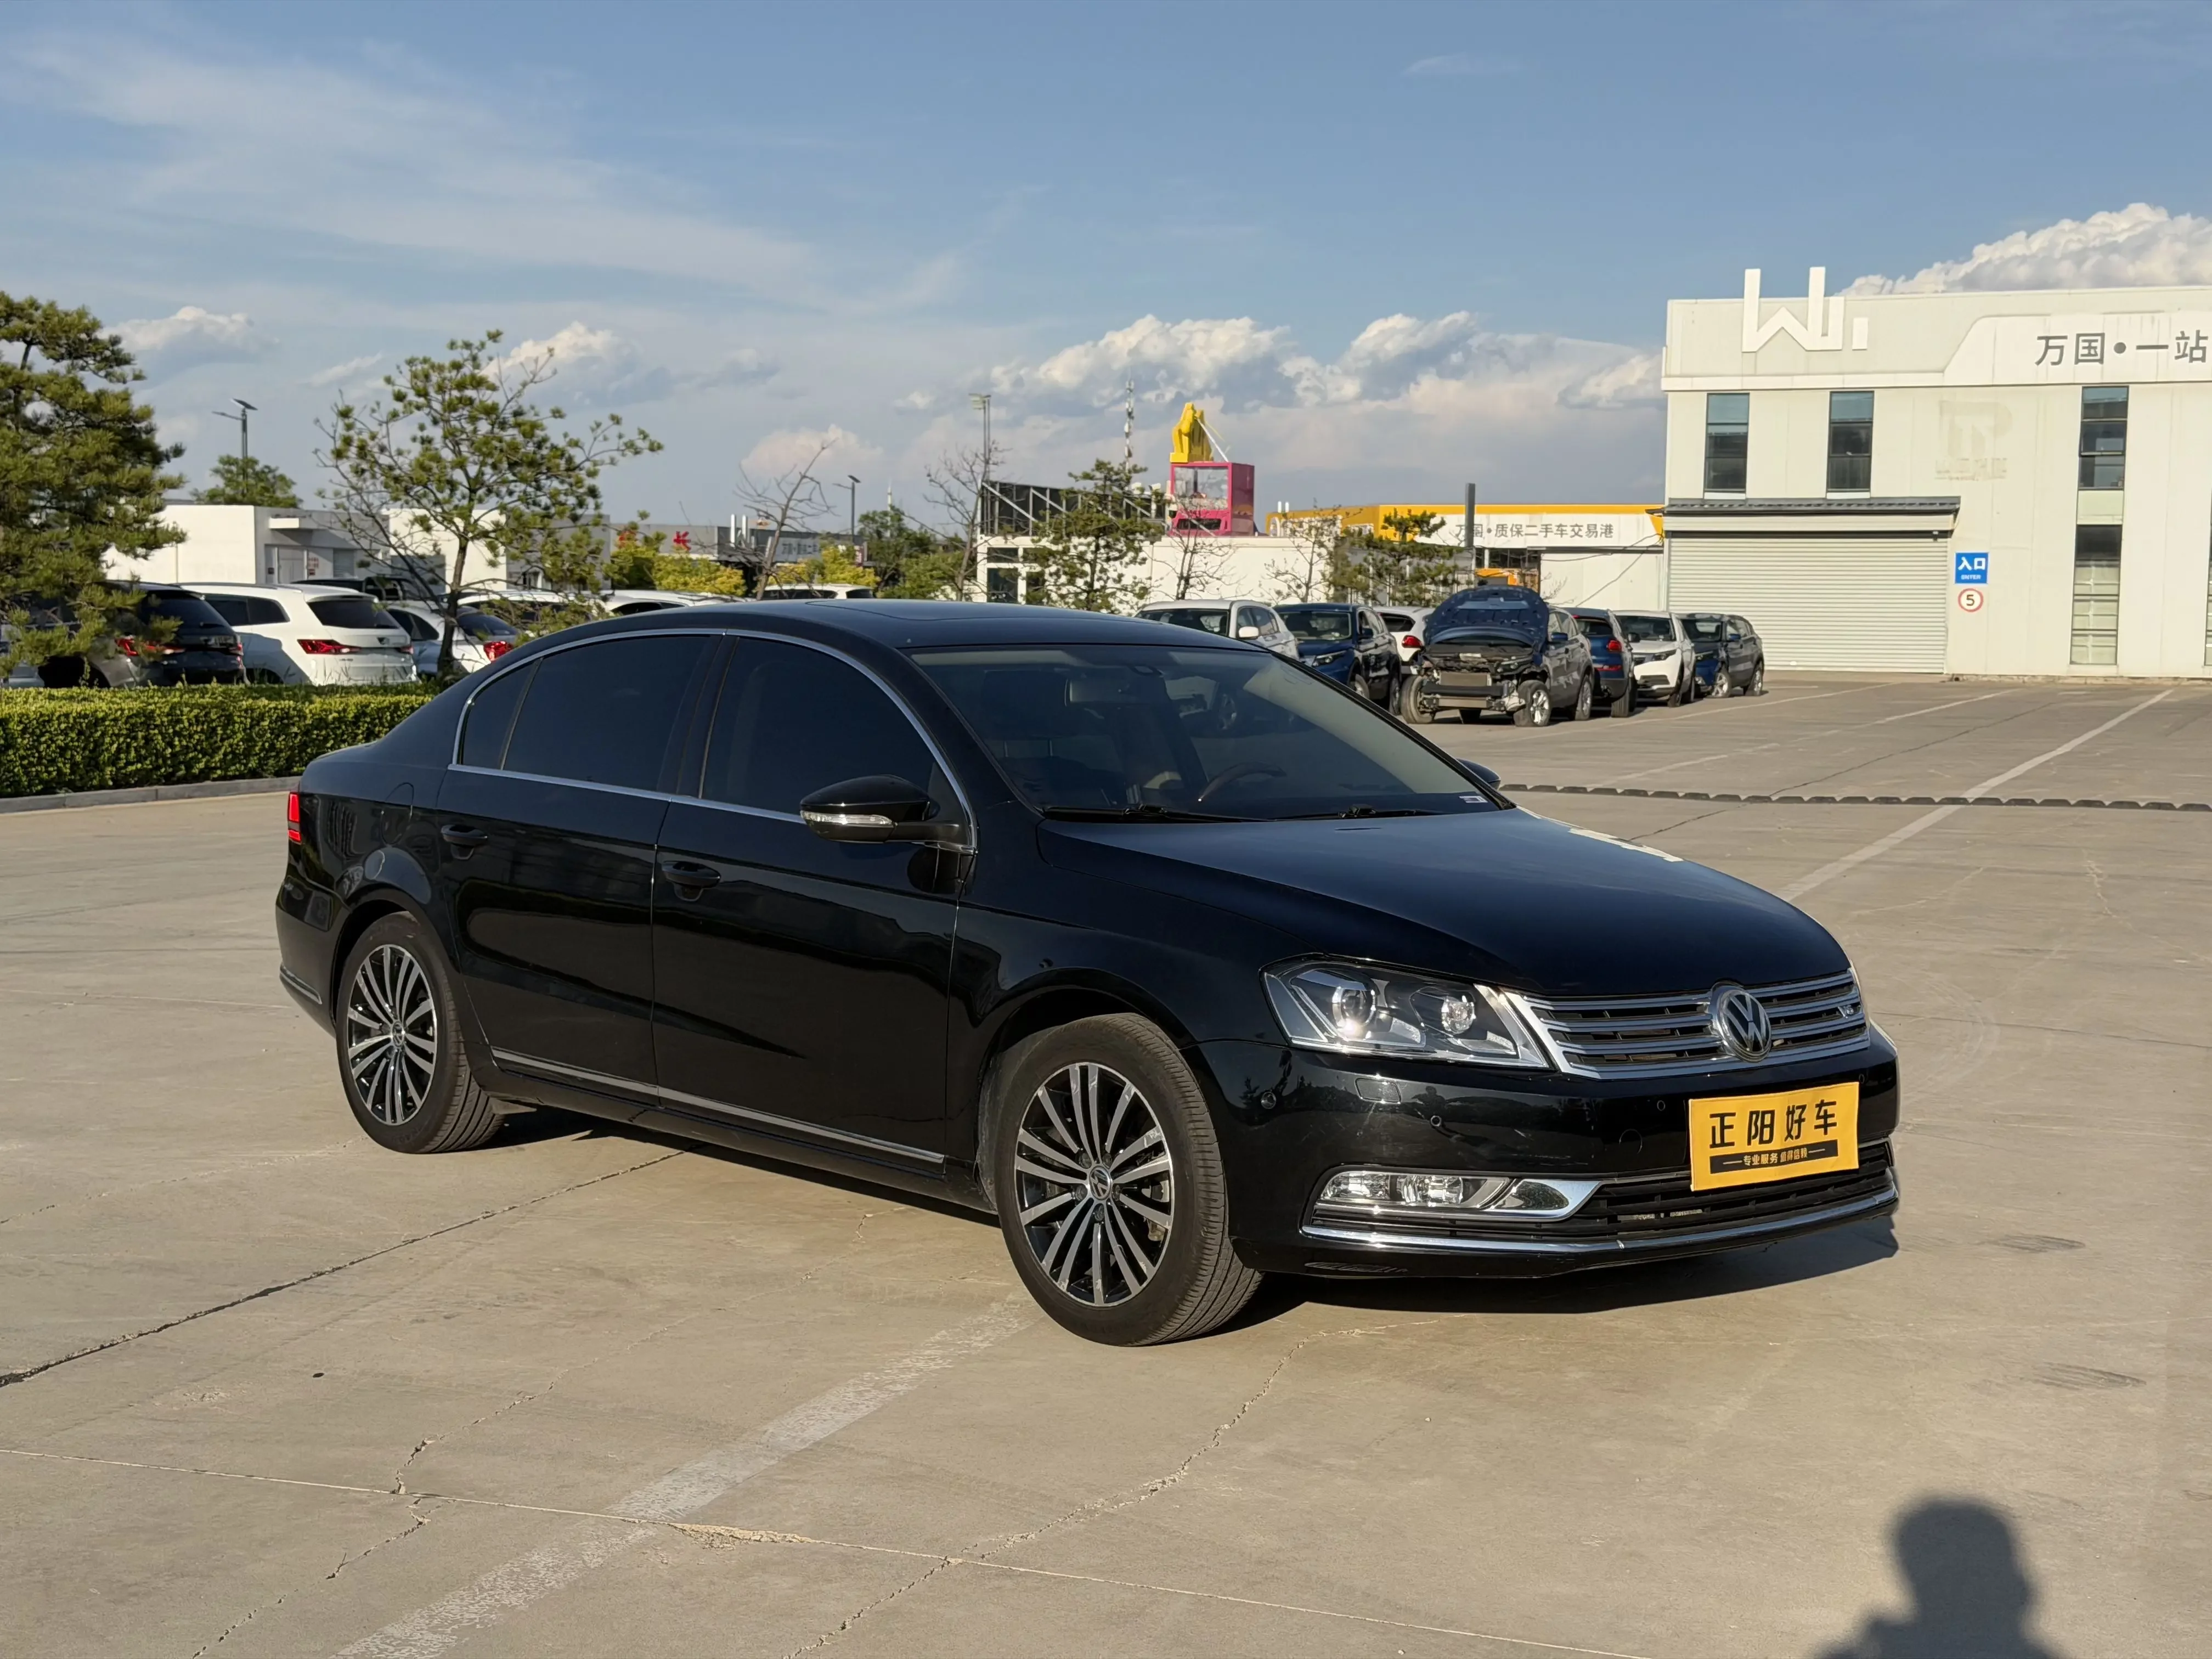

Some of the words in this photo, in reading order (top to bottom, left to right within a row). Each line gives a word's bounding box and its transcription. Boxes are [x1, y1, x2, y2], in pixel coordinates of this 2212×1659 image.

[1957, 556, 1985, 571] 入口
[1966, 594, 1975, 606] 5
[1709, 1099, 1837, 1149] 正阳好车
[1743, 1153, 1778, 1166] 专业服务
